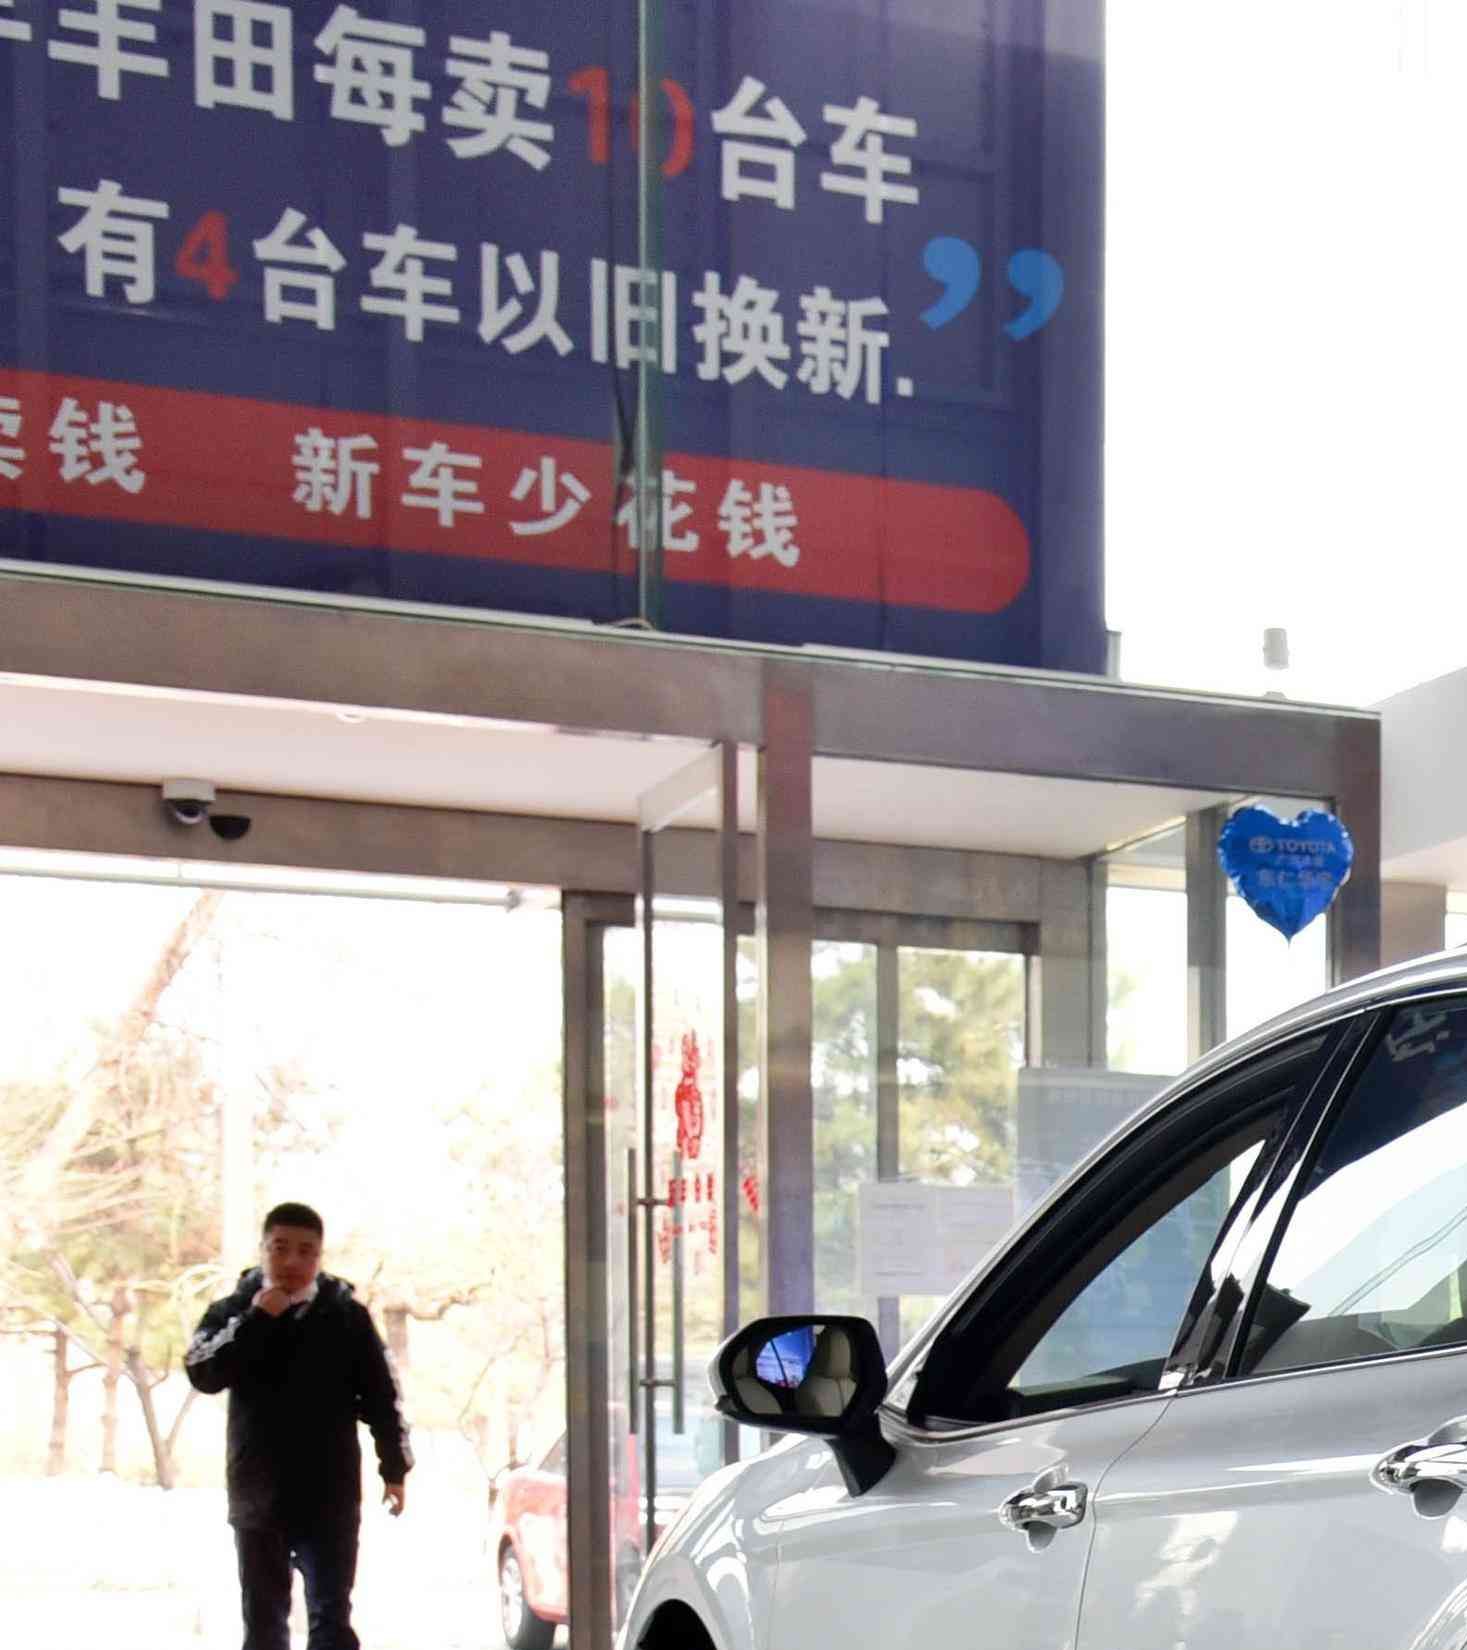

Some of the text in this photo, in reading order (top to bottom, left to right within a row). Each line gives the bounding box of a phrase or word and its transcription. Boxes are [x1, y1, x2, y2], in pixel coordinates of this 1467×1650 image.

[0, 0, 921, 223] 丰田每卖10台车
[0, 396, 801, 569] 钱 新车少花钱
